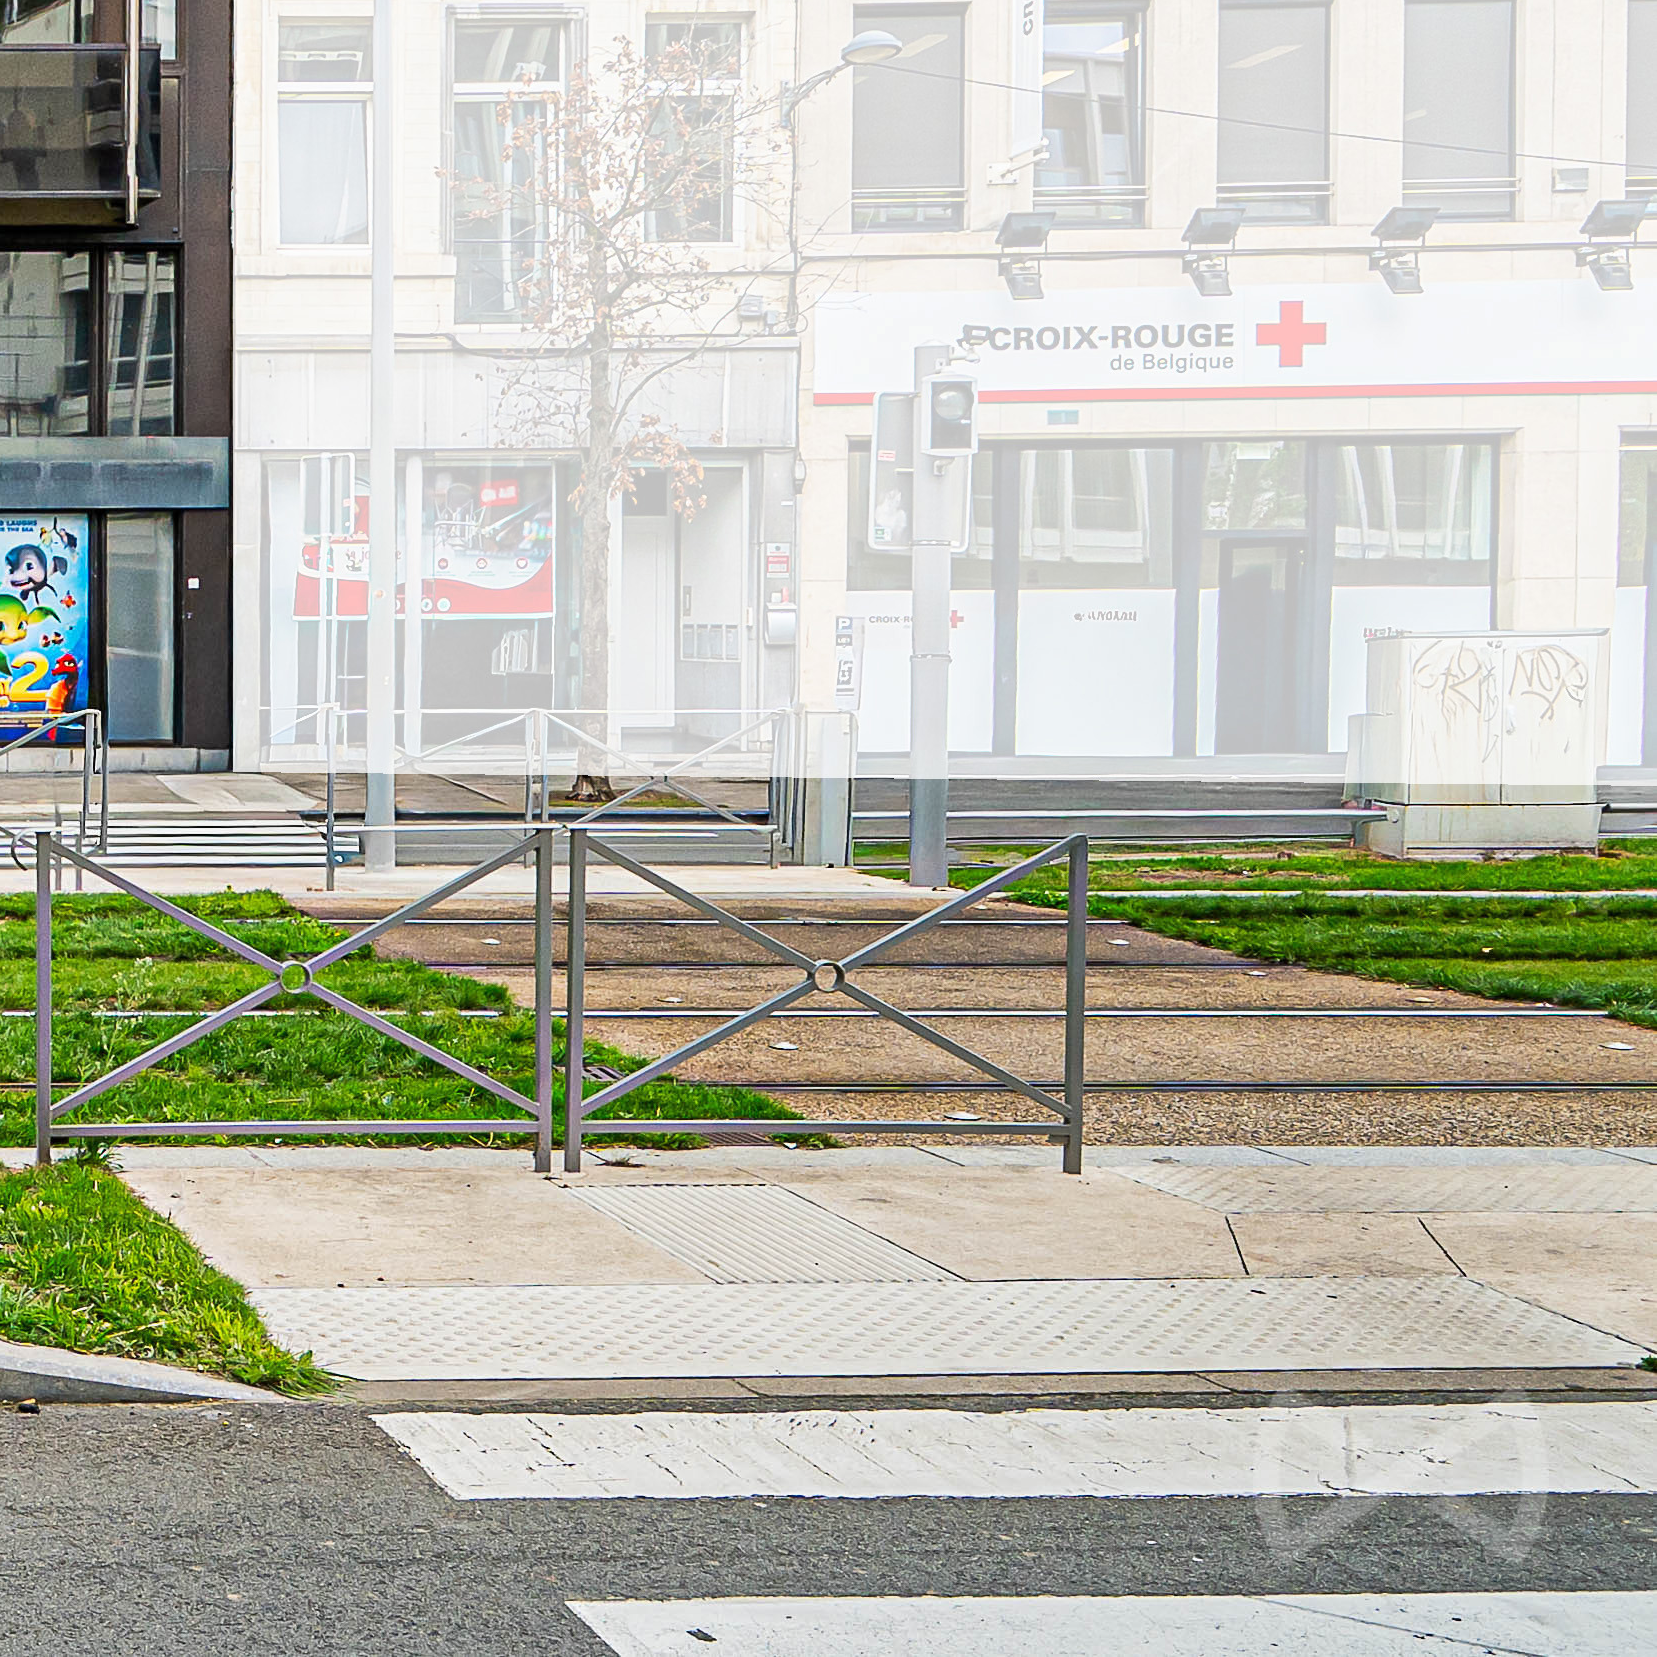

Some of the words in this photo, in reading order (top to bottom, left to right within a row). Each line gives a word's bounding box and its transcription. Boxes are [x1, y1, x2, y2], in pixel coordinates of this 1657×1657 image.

[989, 323, 1234, 351] CROIX-ROUGE
[1110, 354, 1134, 370] de
[1143, 352, 1234, 373] Belgique
[9, 651, 49, 702] 2
